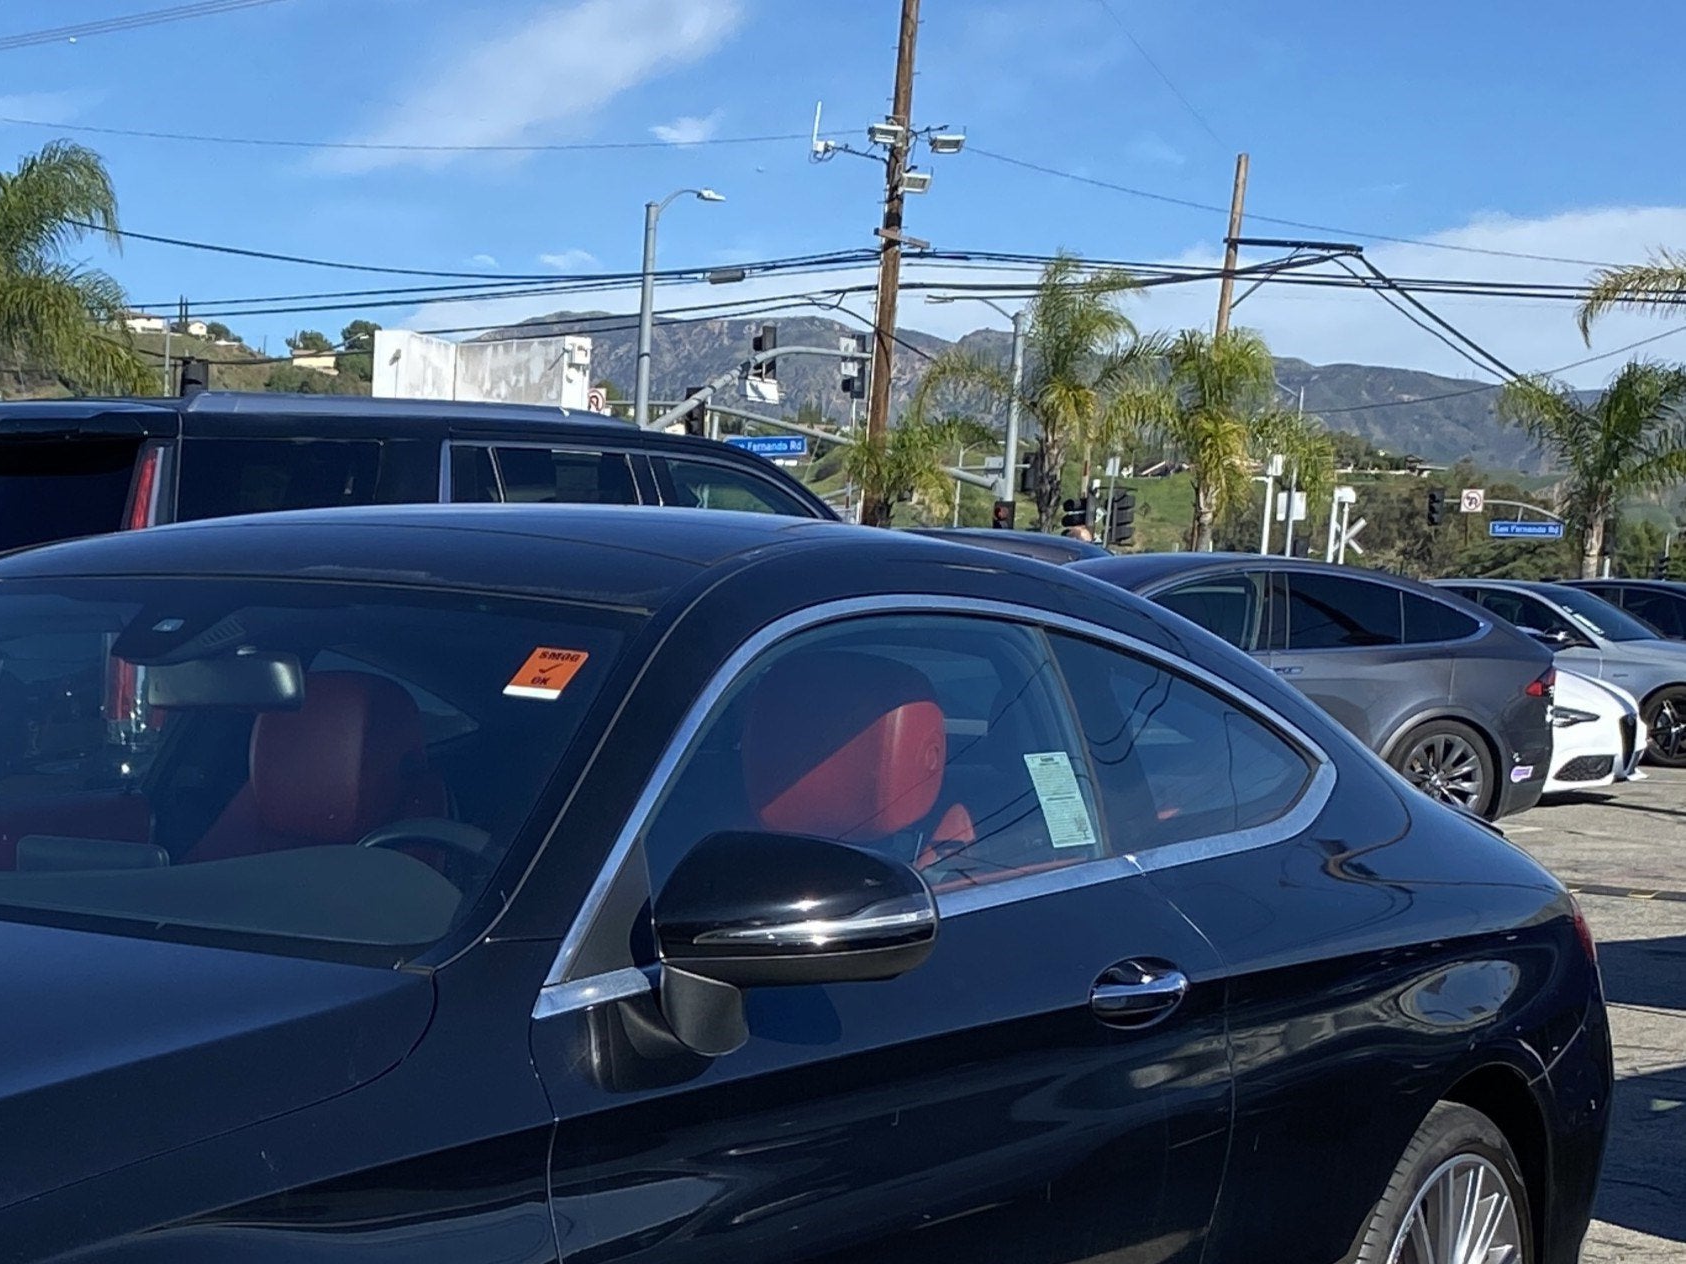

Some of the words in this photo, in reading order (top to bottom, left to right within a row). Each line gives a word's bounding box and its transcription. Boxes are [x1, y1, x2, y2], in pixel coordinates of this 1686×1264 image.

[789, 441, 802, 451] Rd
[1510, 525, 1546, 534] Fernando
[538, 651, 581, 663] SMOG
[531, 676, 551, 686] OK
